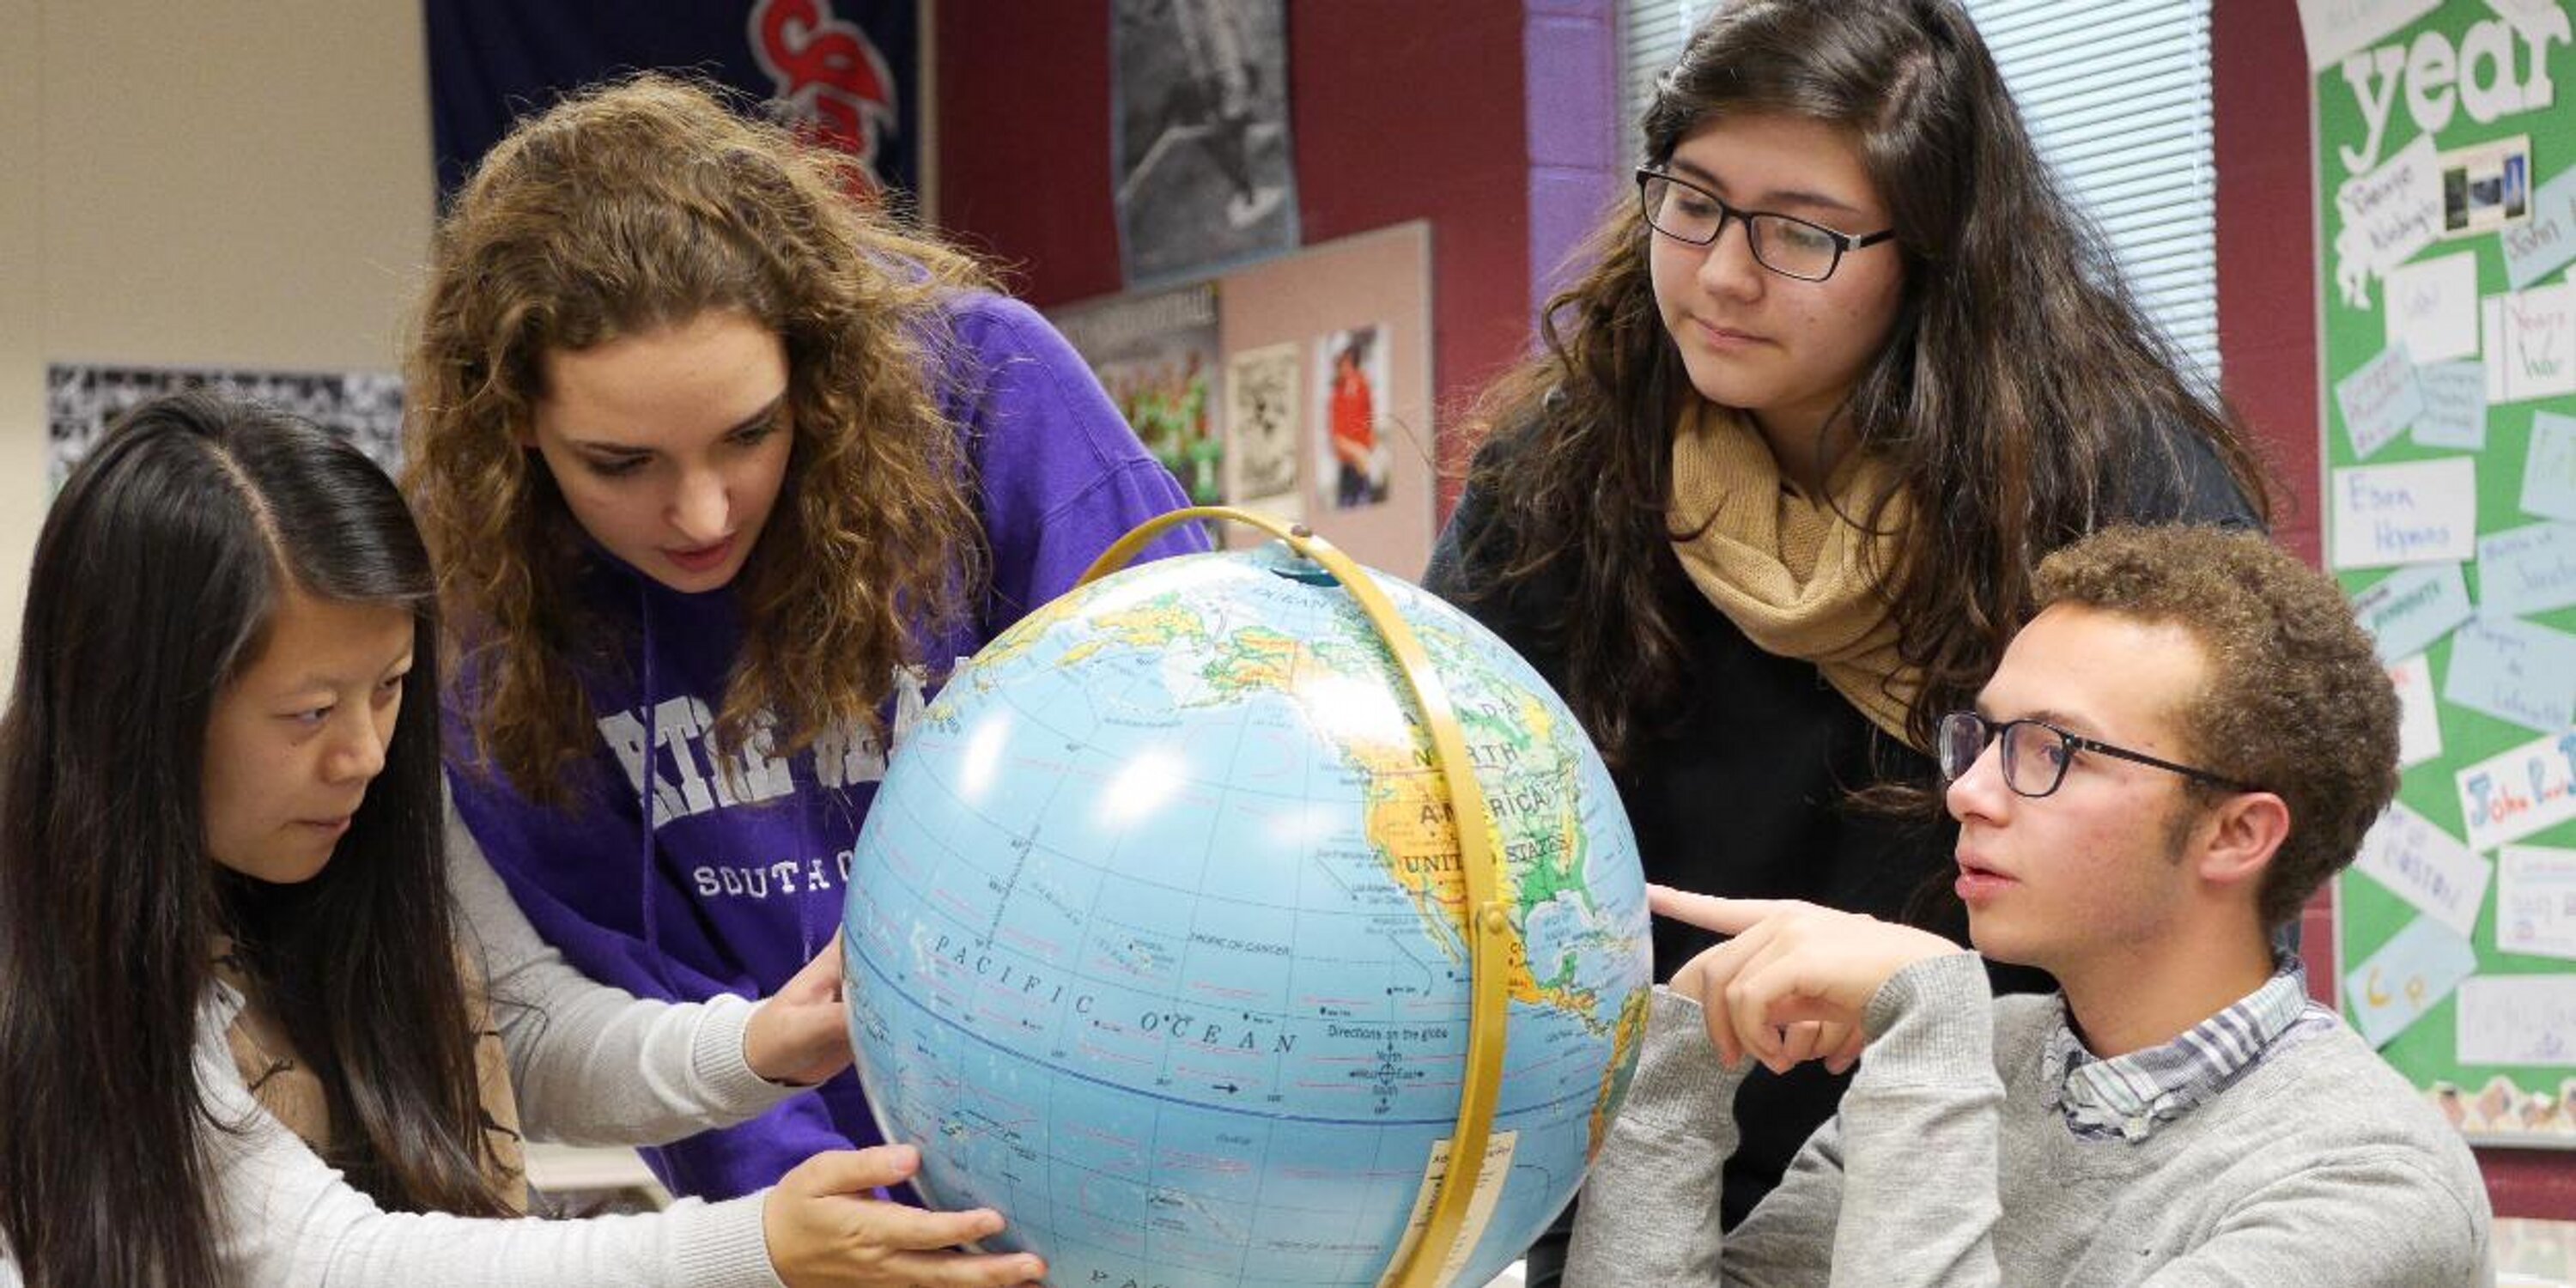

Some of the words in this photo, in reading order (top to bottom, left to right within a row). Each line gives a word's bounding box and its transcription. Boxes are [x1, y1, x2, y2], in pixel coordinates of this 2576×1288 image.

[2338, 7, 2572, 177] year
[694, 860, 831, 898] SOUTH
[1403, 852, 1463, 874] UNIT
[934, 934, 1095, 1015] PACIFIC
[1139, 1011, 1297, 1054] OCEAN
[1327, 1024, 1382, 1040] Directions
